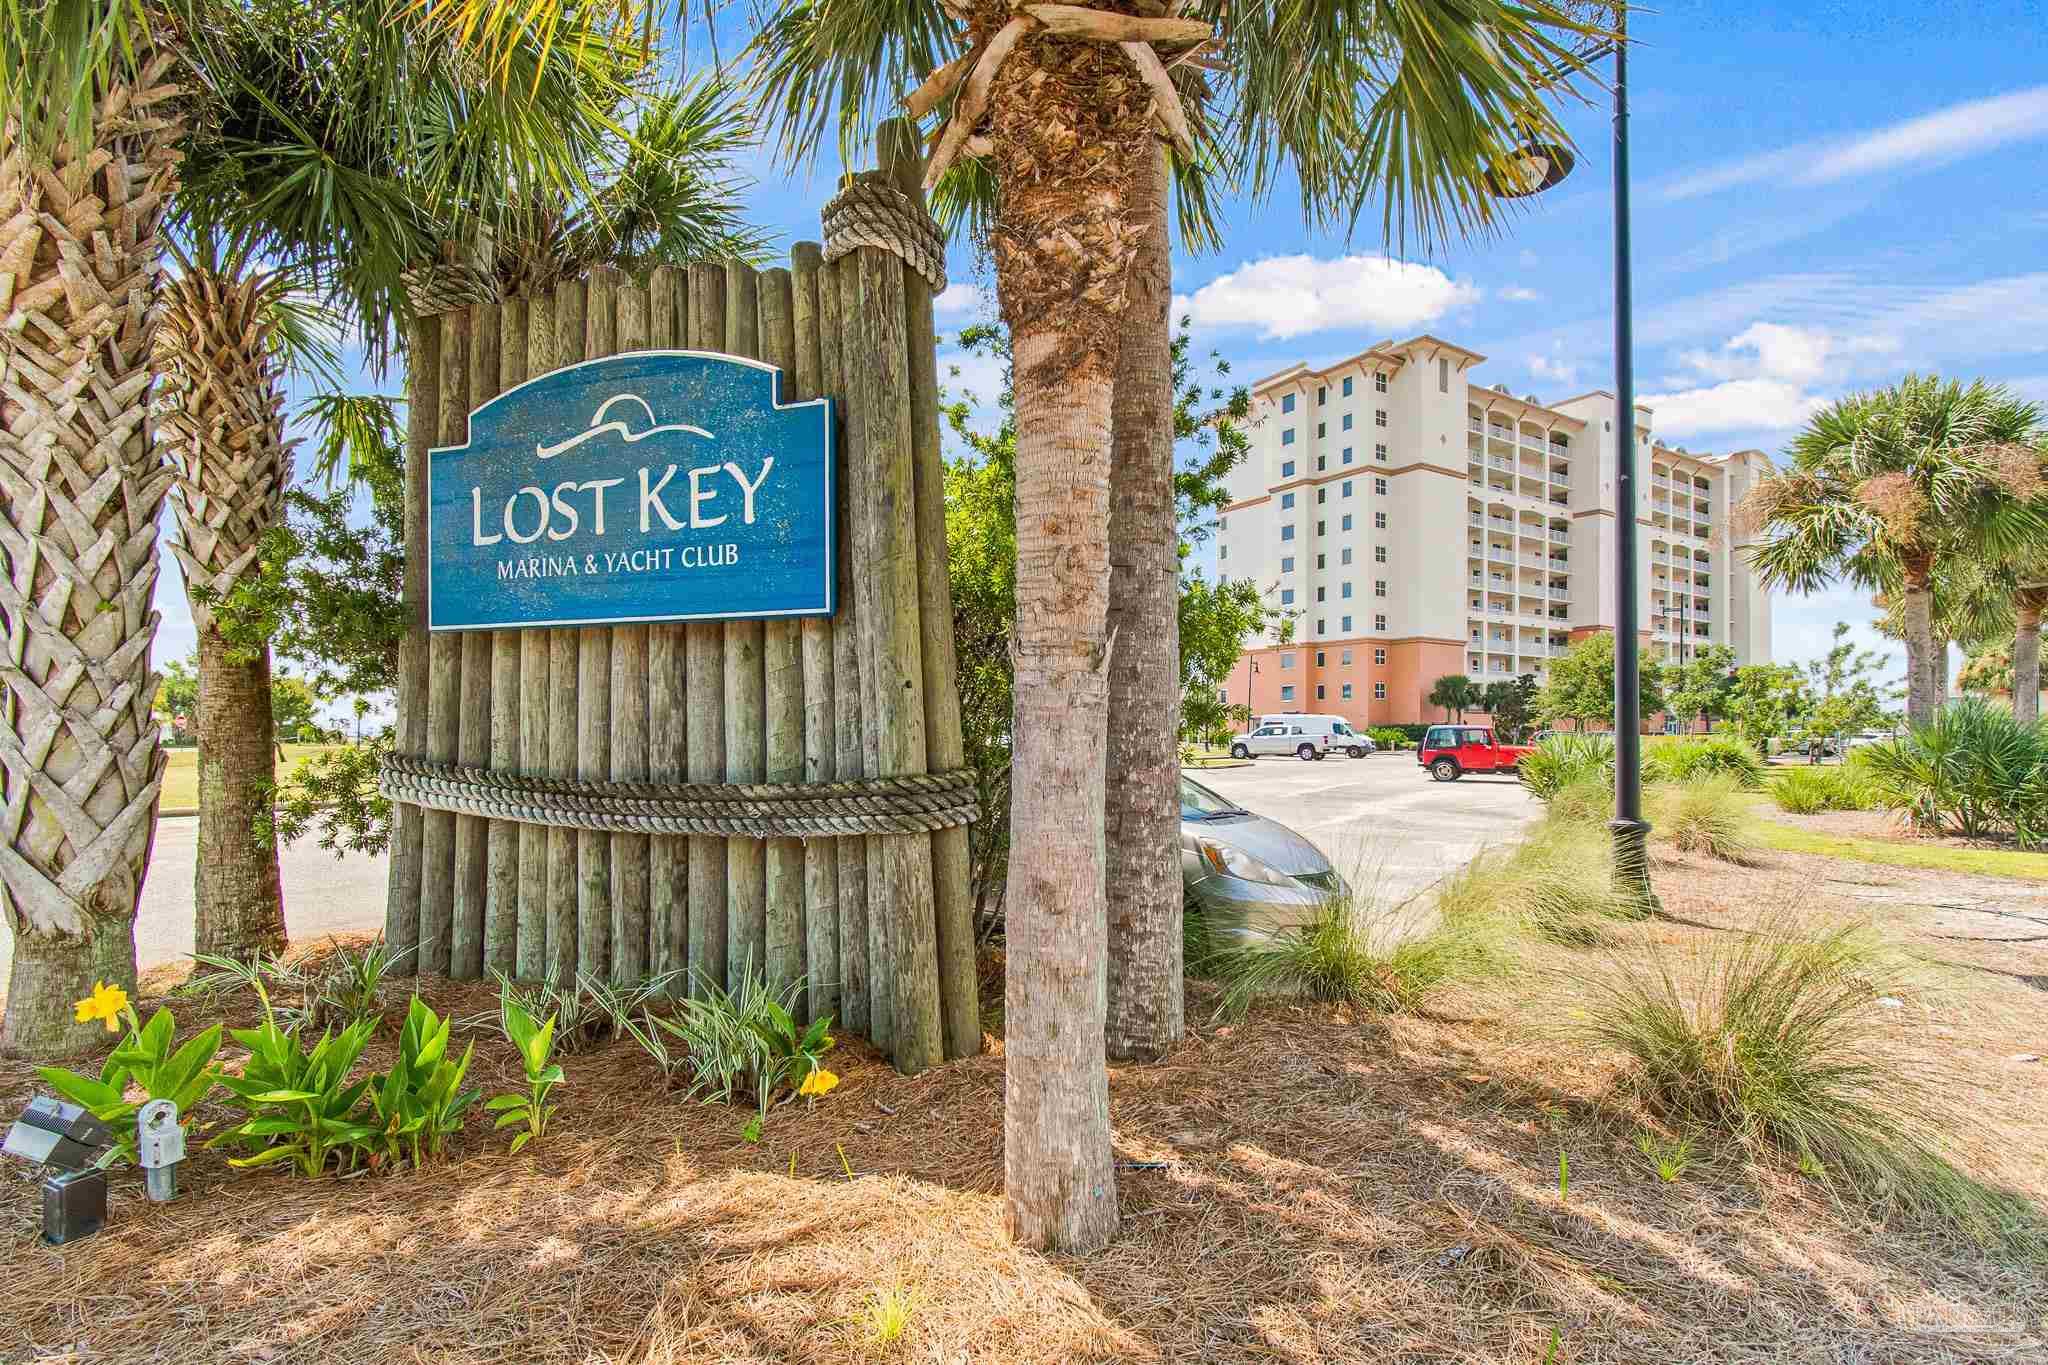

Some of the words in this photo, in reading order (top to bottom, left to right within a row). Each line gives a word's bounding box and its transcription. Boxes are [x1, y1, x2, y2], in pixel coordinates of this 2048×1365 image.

[472, 478, 624, 546] LOST
[638, 456, 774, 533] KEY
[497, 556, 578, 579] MARINA
[584, 554, 598, 574] &
[605, 548, 674, 572] YACHT
[682, 543, 739, 567] CLUB
